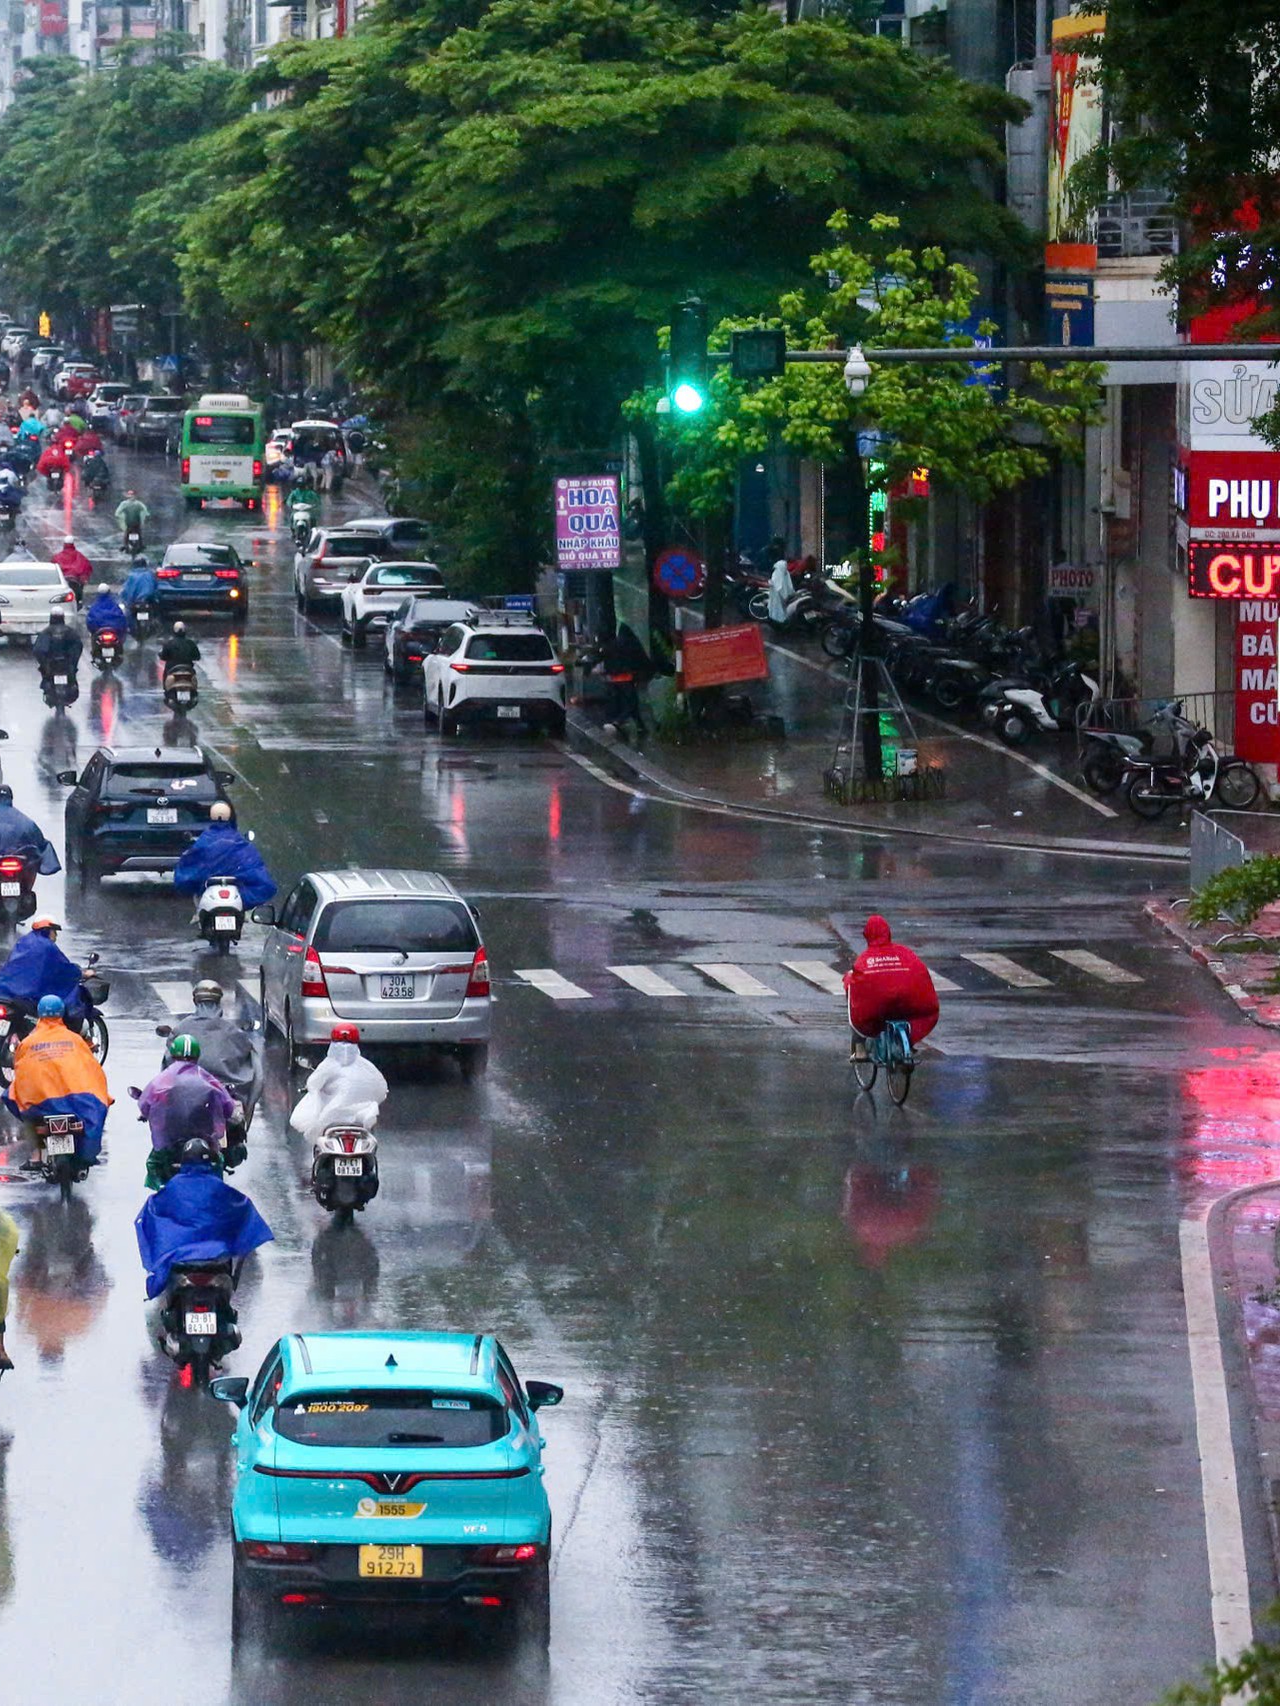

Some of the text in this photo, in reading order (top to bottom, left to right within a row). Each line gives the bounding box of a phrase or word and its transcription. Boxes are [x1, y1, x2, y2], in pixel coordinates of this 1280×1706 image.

[568, 487, 617, 507] HOA
[1208, 479, 1271, 527] PHỤ
[568, 507, 618, 534] QUẢ
[390, 976, 406, 986] 30A
[307, 1404, 369, 1413] 1900 2097
[379, 1505, 406, 1516] 1555
[378, 1546, 405, 1560] 29H
[366, 1561, 415, 1575] 912.73
